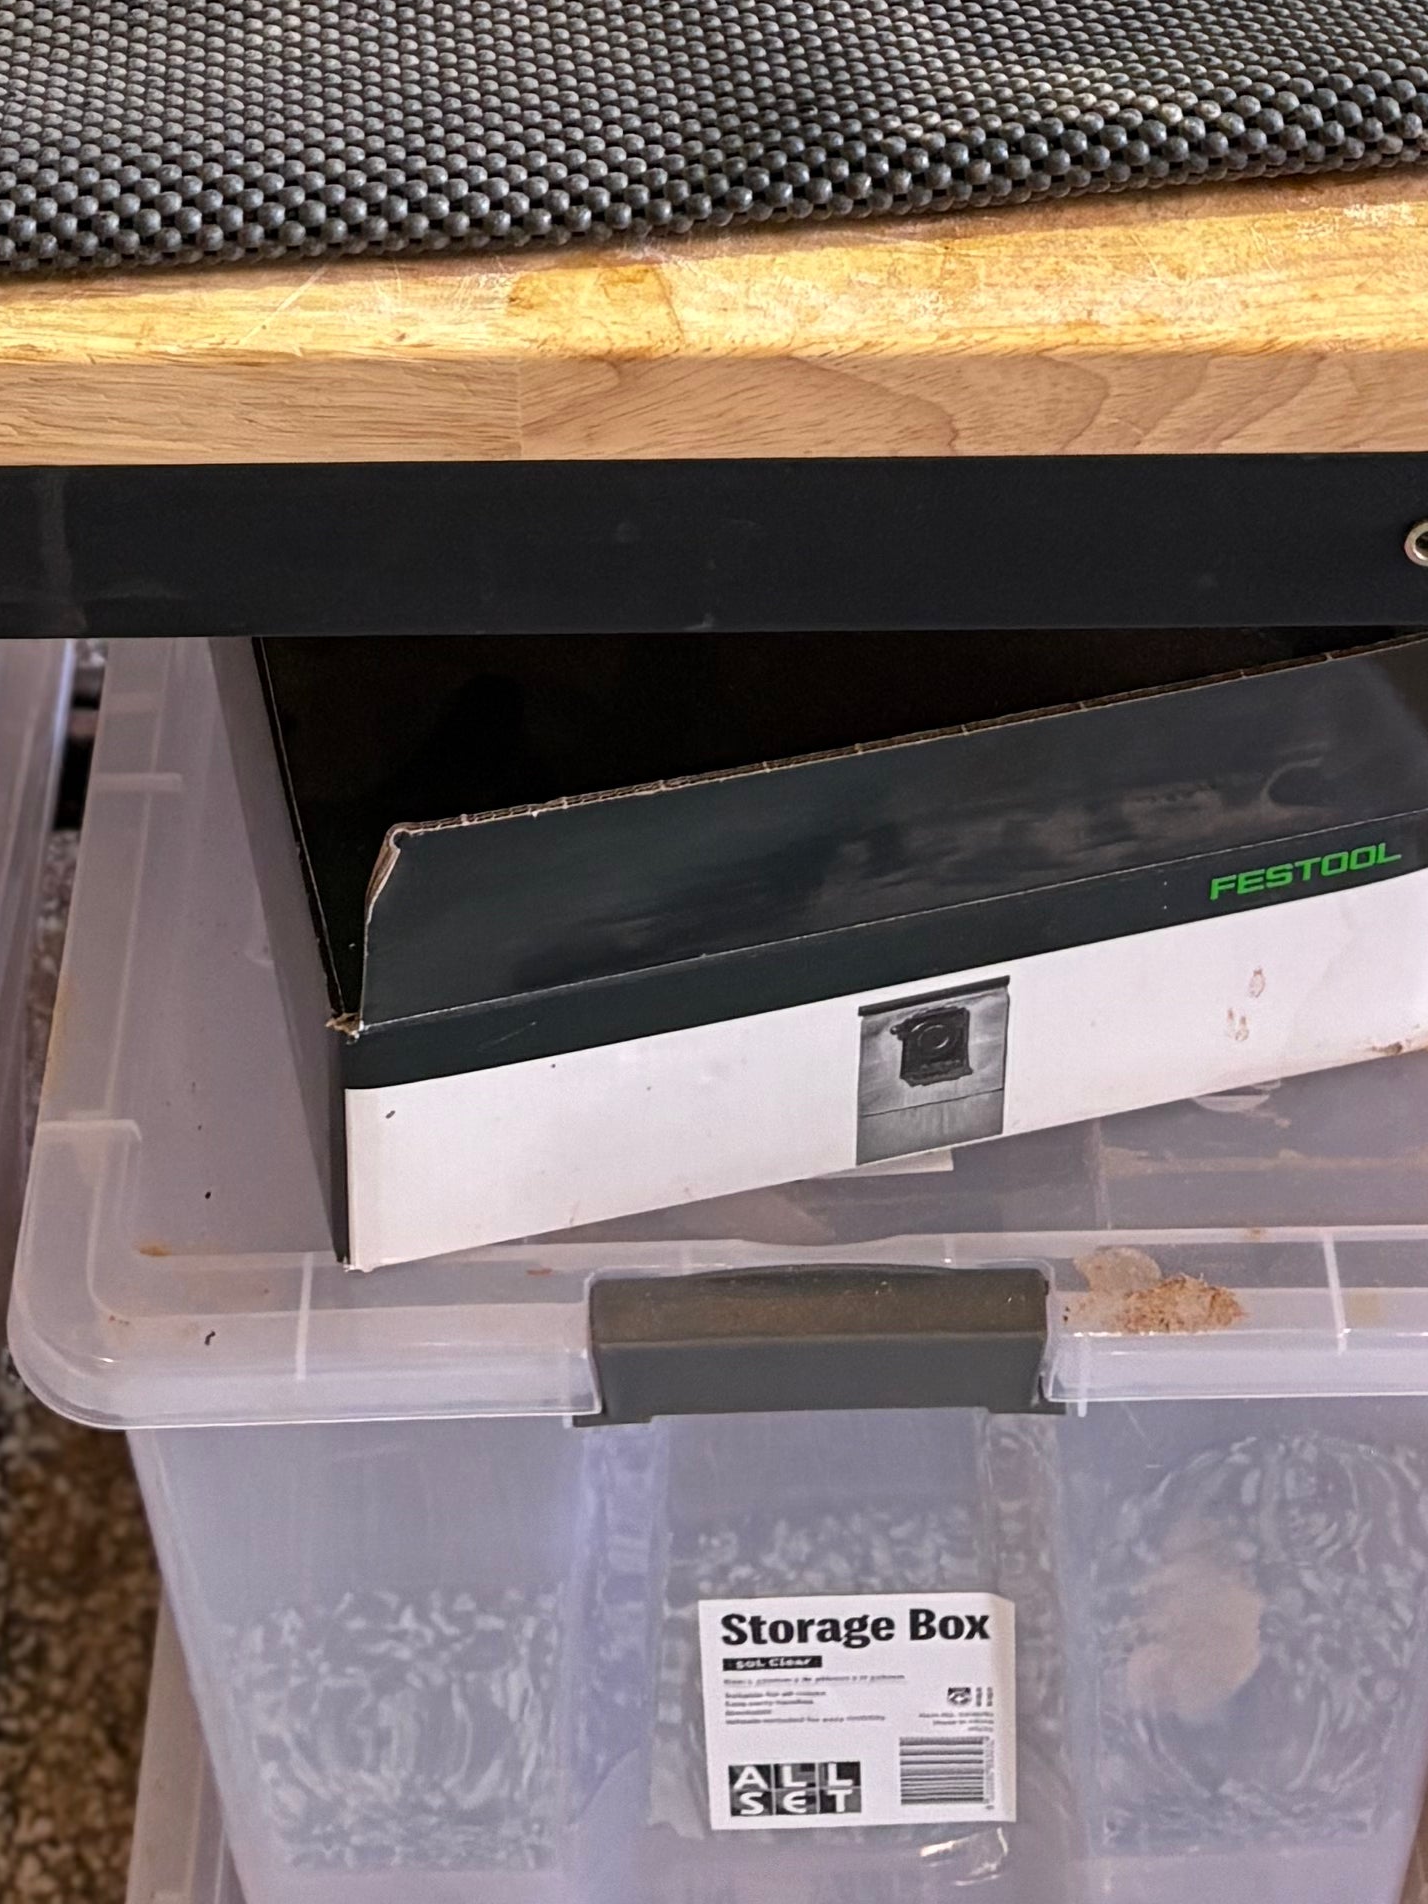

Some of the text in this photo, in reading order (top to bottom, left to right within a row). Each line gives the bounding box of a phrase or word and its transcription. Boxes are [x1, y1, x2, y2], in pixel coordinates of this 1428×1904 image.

[1210, 843, 1401, 900] FESTOOL
[720, 1608, 990, 1648] Storage Box
[734, 1764, 853, 1790] ALL
